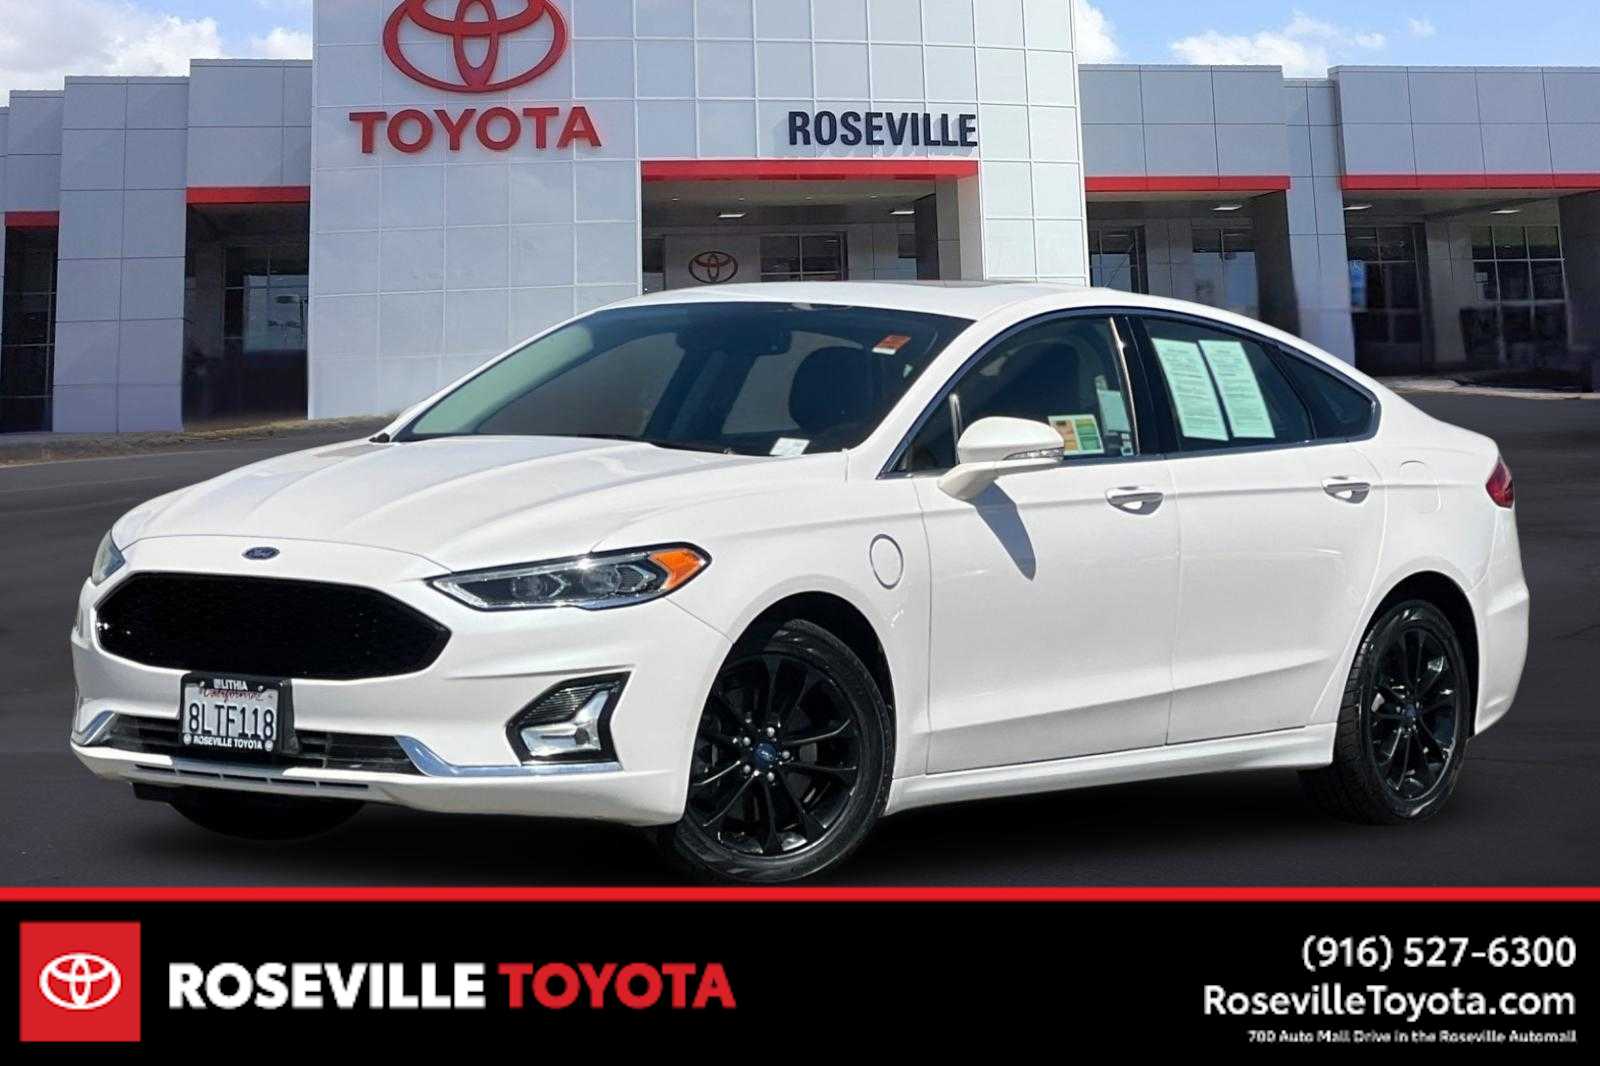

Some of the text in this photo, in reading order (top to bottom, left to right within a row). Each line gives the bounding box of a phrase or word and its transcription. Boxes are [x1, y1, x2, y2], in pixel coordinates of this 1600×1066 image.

[349, 106, 602, 154] TOYOTA
[788, 111, 978, 147] ROSEVILLE
[189, 703, 275, 741] 8LTF118
[193, 736, 263, 750] ROSEVILLE TOYOTA
